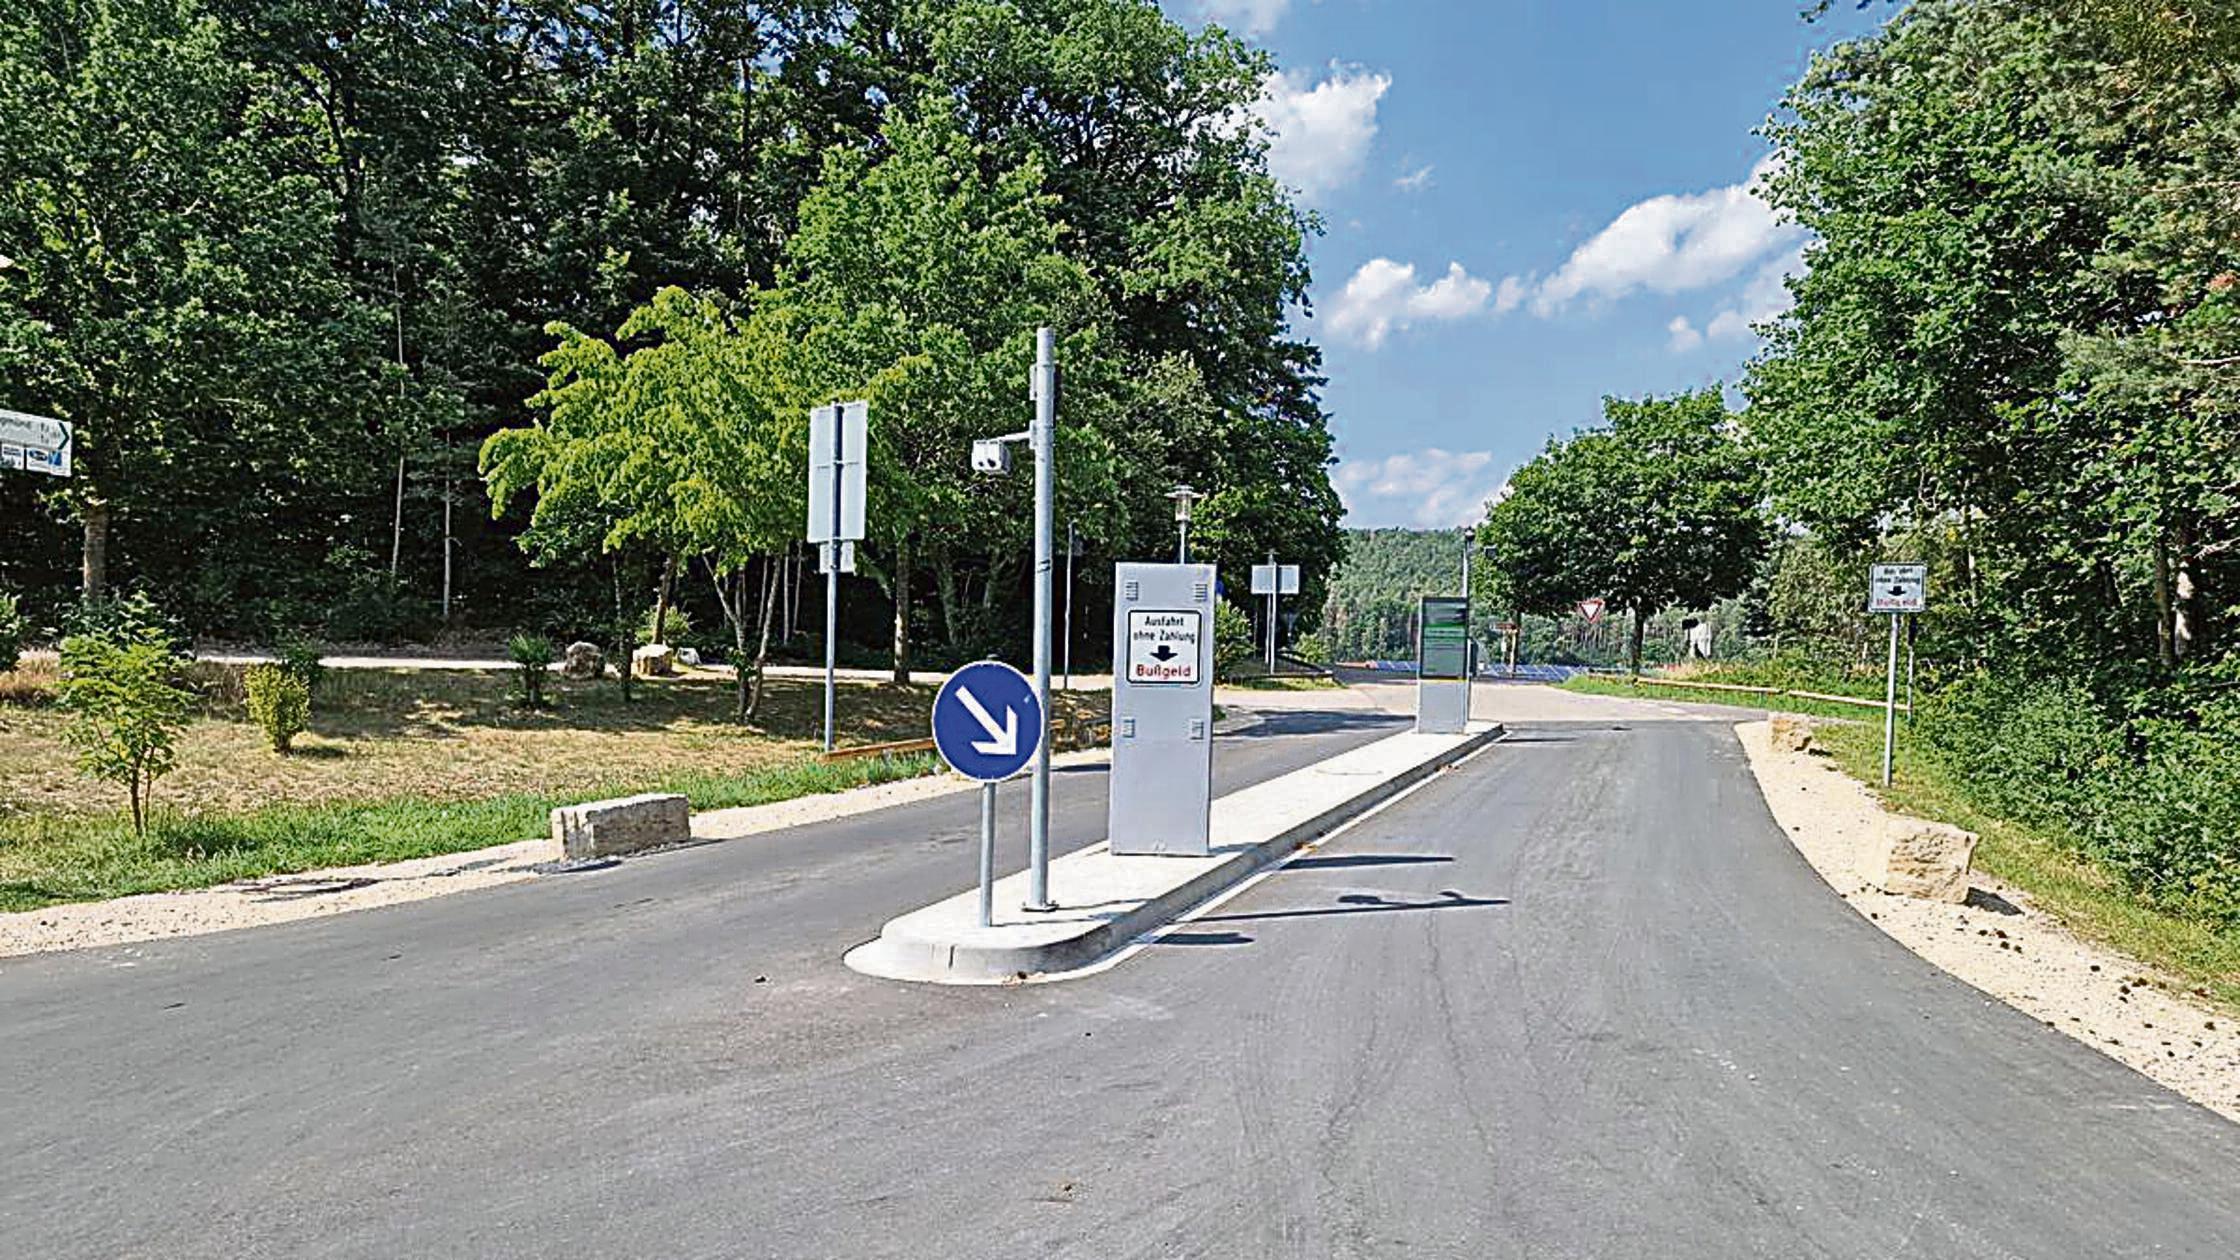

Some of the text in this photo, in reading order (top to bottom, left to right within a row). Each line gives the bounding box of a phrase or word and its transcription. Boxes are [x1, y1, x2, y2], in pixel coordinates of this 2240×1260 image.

[1144, 615, 1184, 626] Ausfahrt
[1133, 628, 1195, 645] ohne Zahlung
[1136, 663, 1191, 680] Bußgeld
